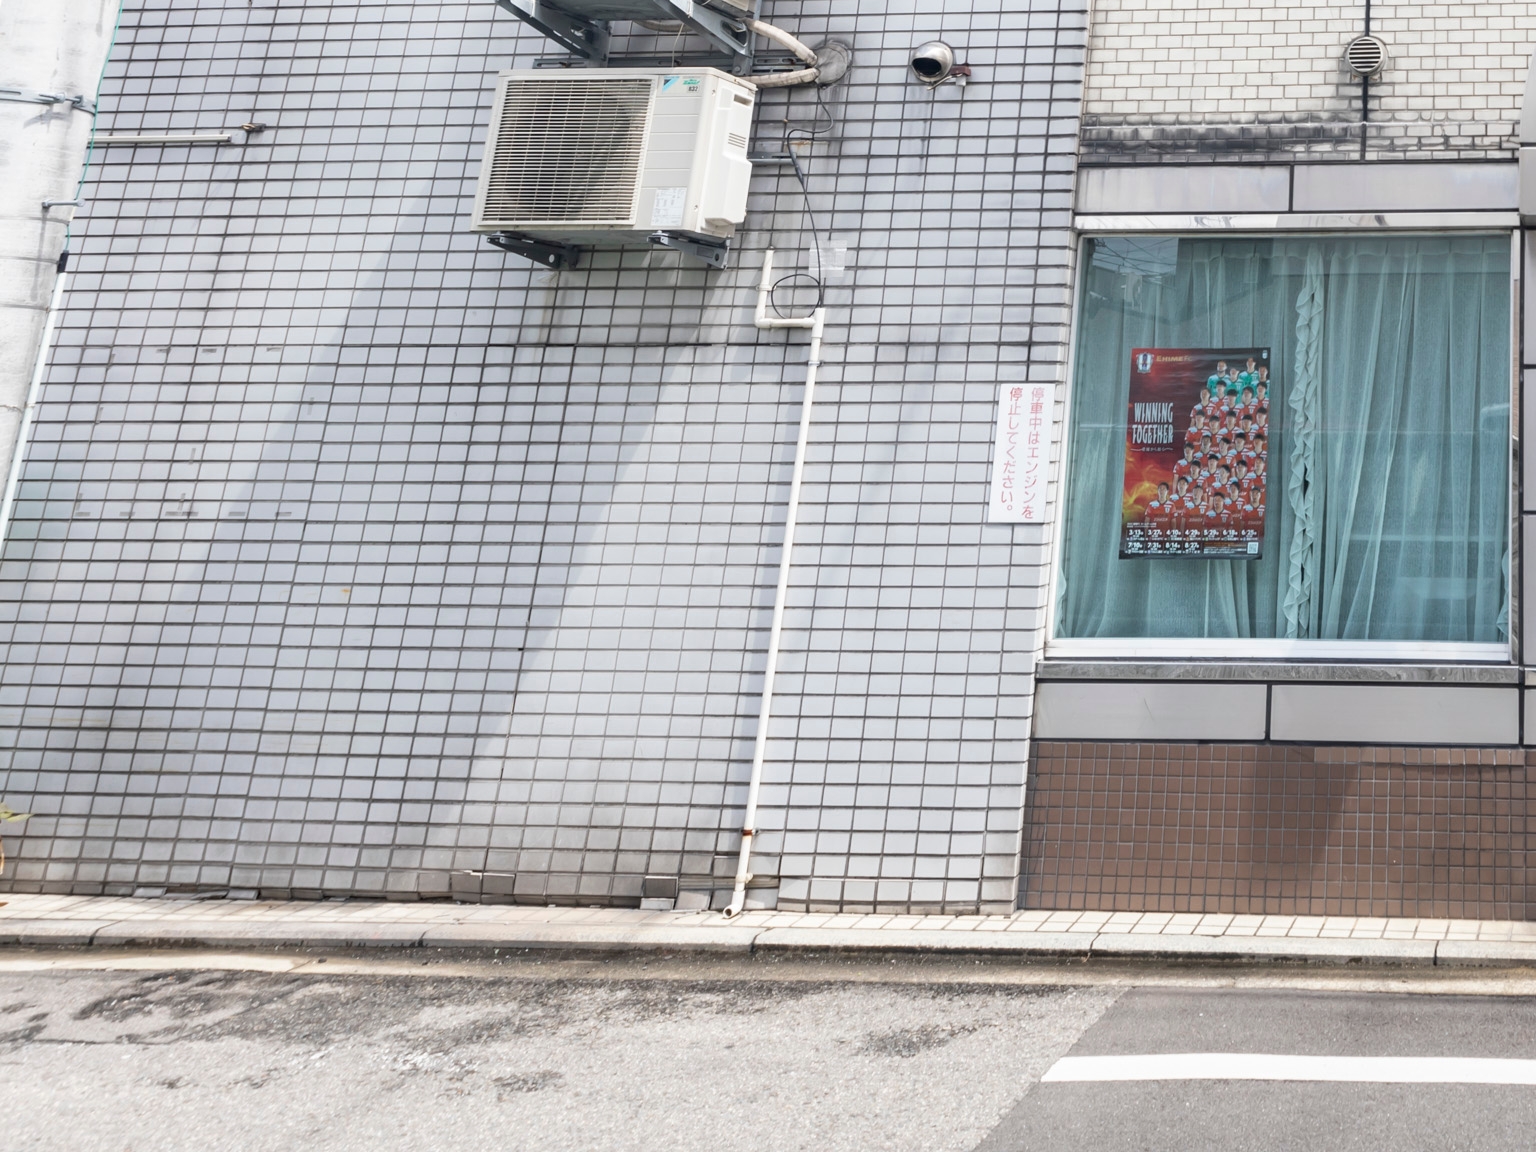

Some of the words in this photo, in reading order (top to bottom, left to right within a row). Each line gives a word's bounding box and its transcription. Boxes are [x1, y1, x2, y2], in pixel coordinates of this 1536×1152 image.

[1132, 424, 1174, 444] TOGETHER
[1134, 402, 1174, 423] WINNING
[1001, 387, 1023, 511] 停止してください。
[1021, 387, 1045, 519] 停車中はエンジンを
